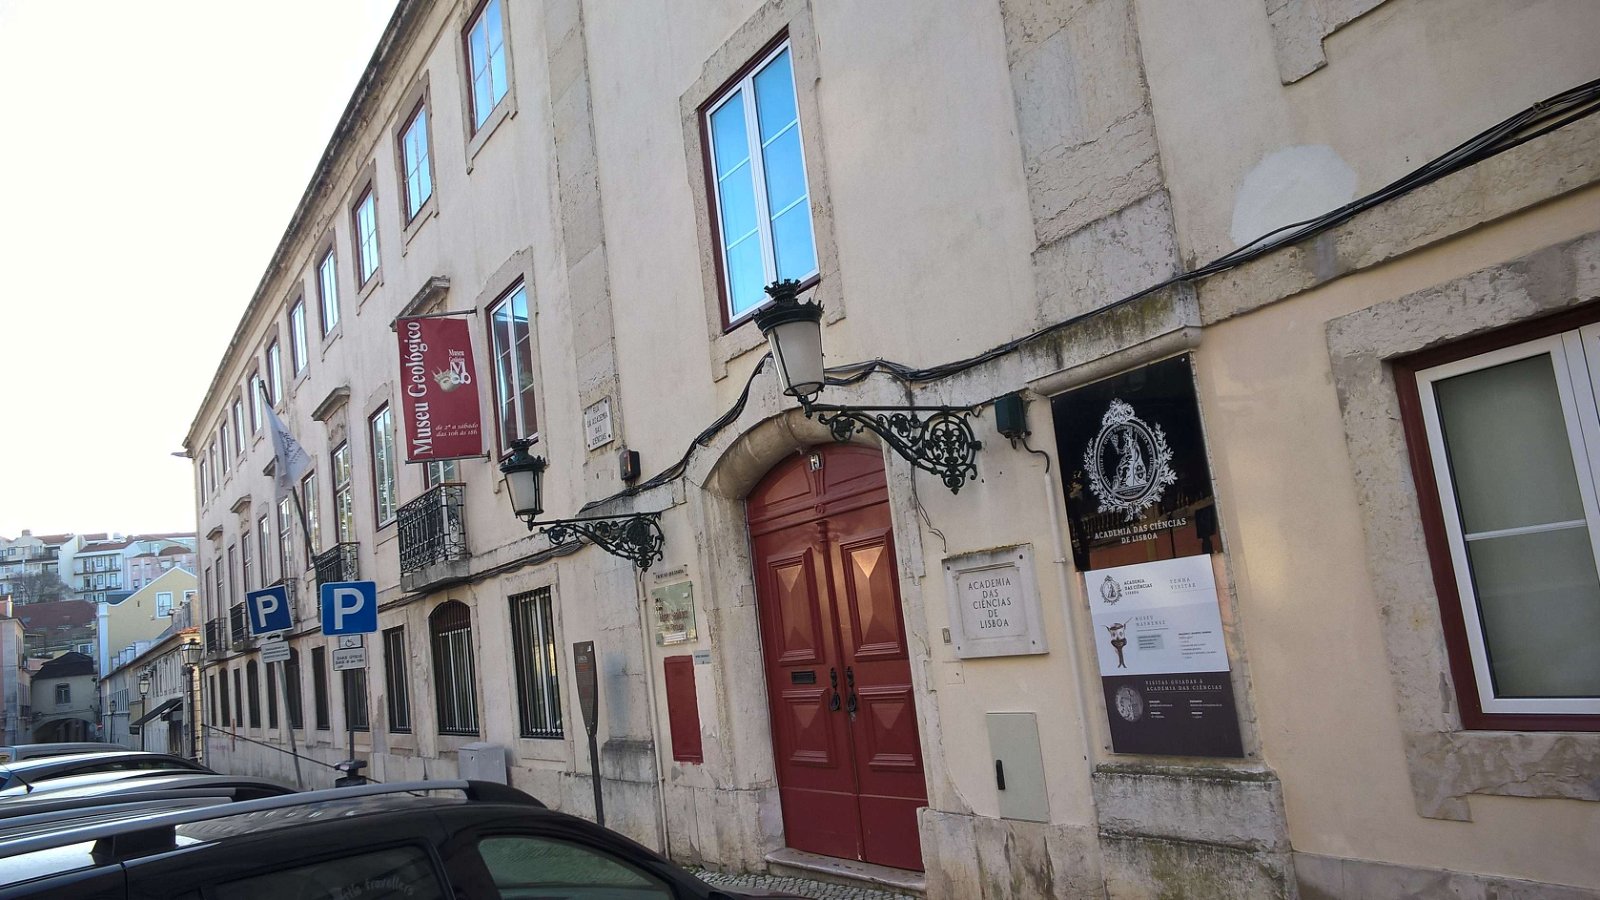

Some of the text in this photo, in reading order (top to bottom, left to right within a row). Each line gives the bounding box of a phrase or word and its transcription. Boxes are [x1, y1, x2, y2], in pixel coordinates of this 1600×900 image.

[404, 322, 433, 456] Museu Geológico
[1094, 517, 1187, 540] ACADEMIA DAS CIÊNCIAS
[1132, 533, 1158, 543] LISBOA
[968, 577, 1011, 591] ACADEMIA
[982, 589, 999, 599] DAS
[256, 594, 279, 628] P
[333, 588, 365, 630] P
[987, 609, 998, 618] DE
[980, 619, 1009, 629] LISBOA
